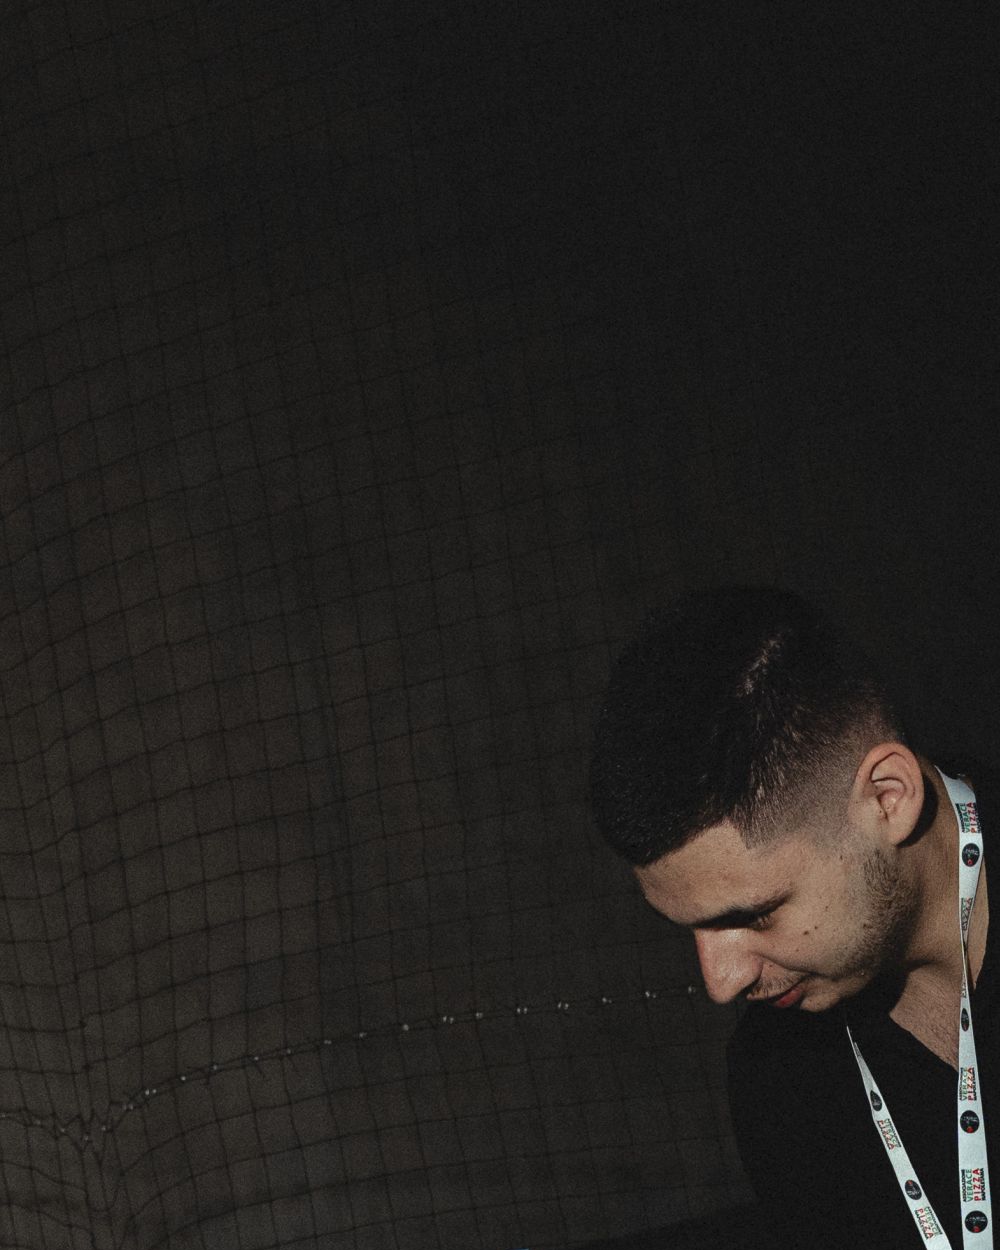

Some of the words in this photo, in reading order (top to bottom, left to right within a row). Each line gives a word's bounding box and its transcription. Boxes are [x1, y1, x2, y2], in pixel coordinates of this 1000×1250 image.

[960, 803, 971, 833] VERACE
[966, 802, 977, 833] PIZZA
[965, 1168, 974, 1202] VERACE
[972, 1167, 982, 1201] PIZZA
[918, 1208, 934, 1238] PIZZA
